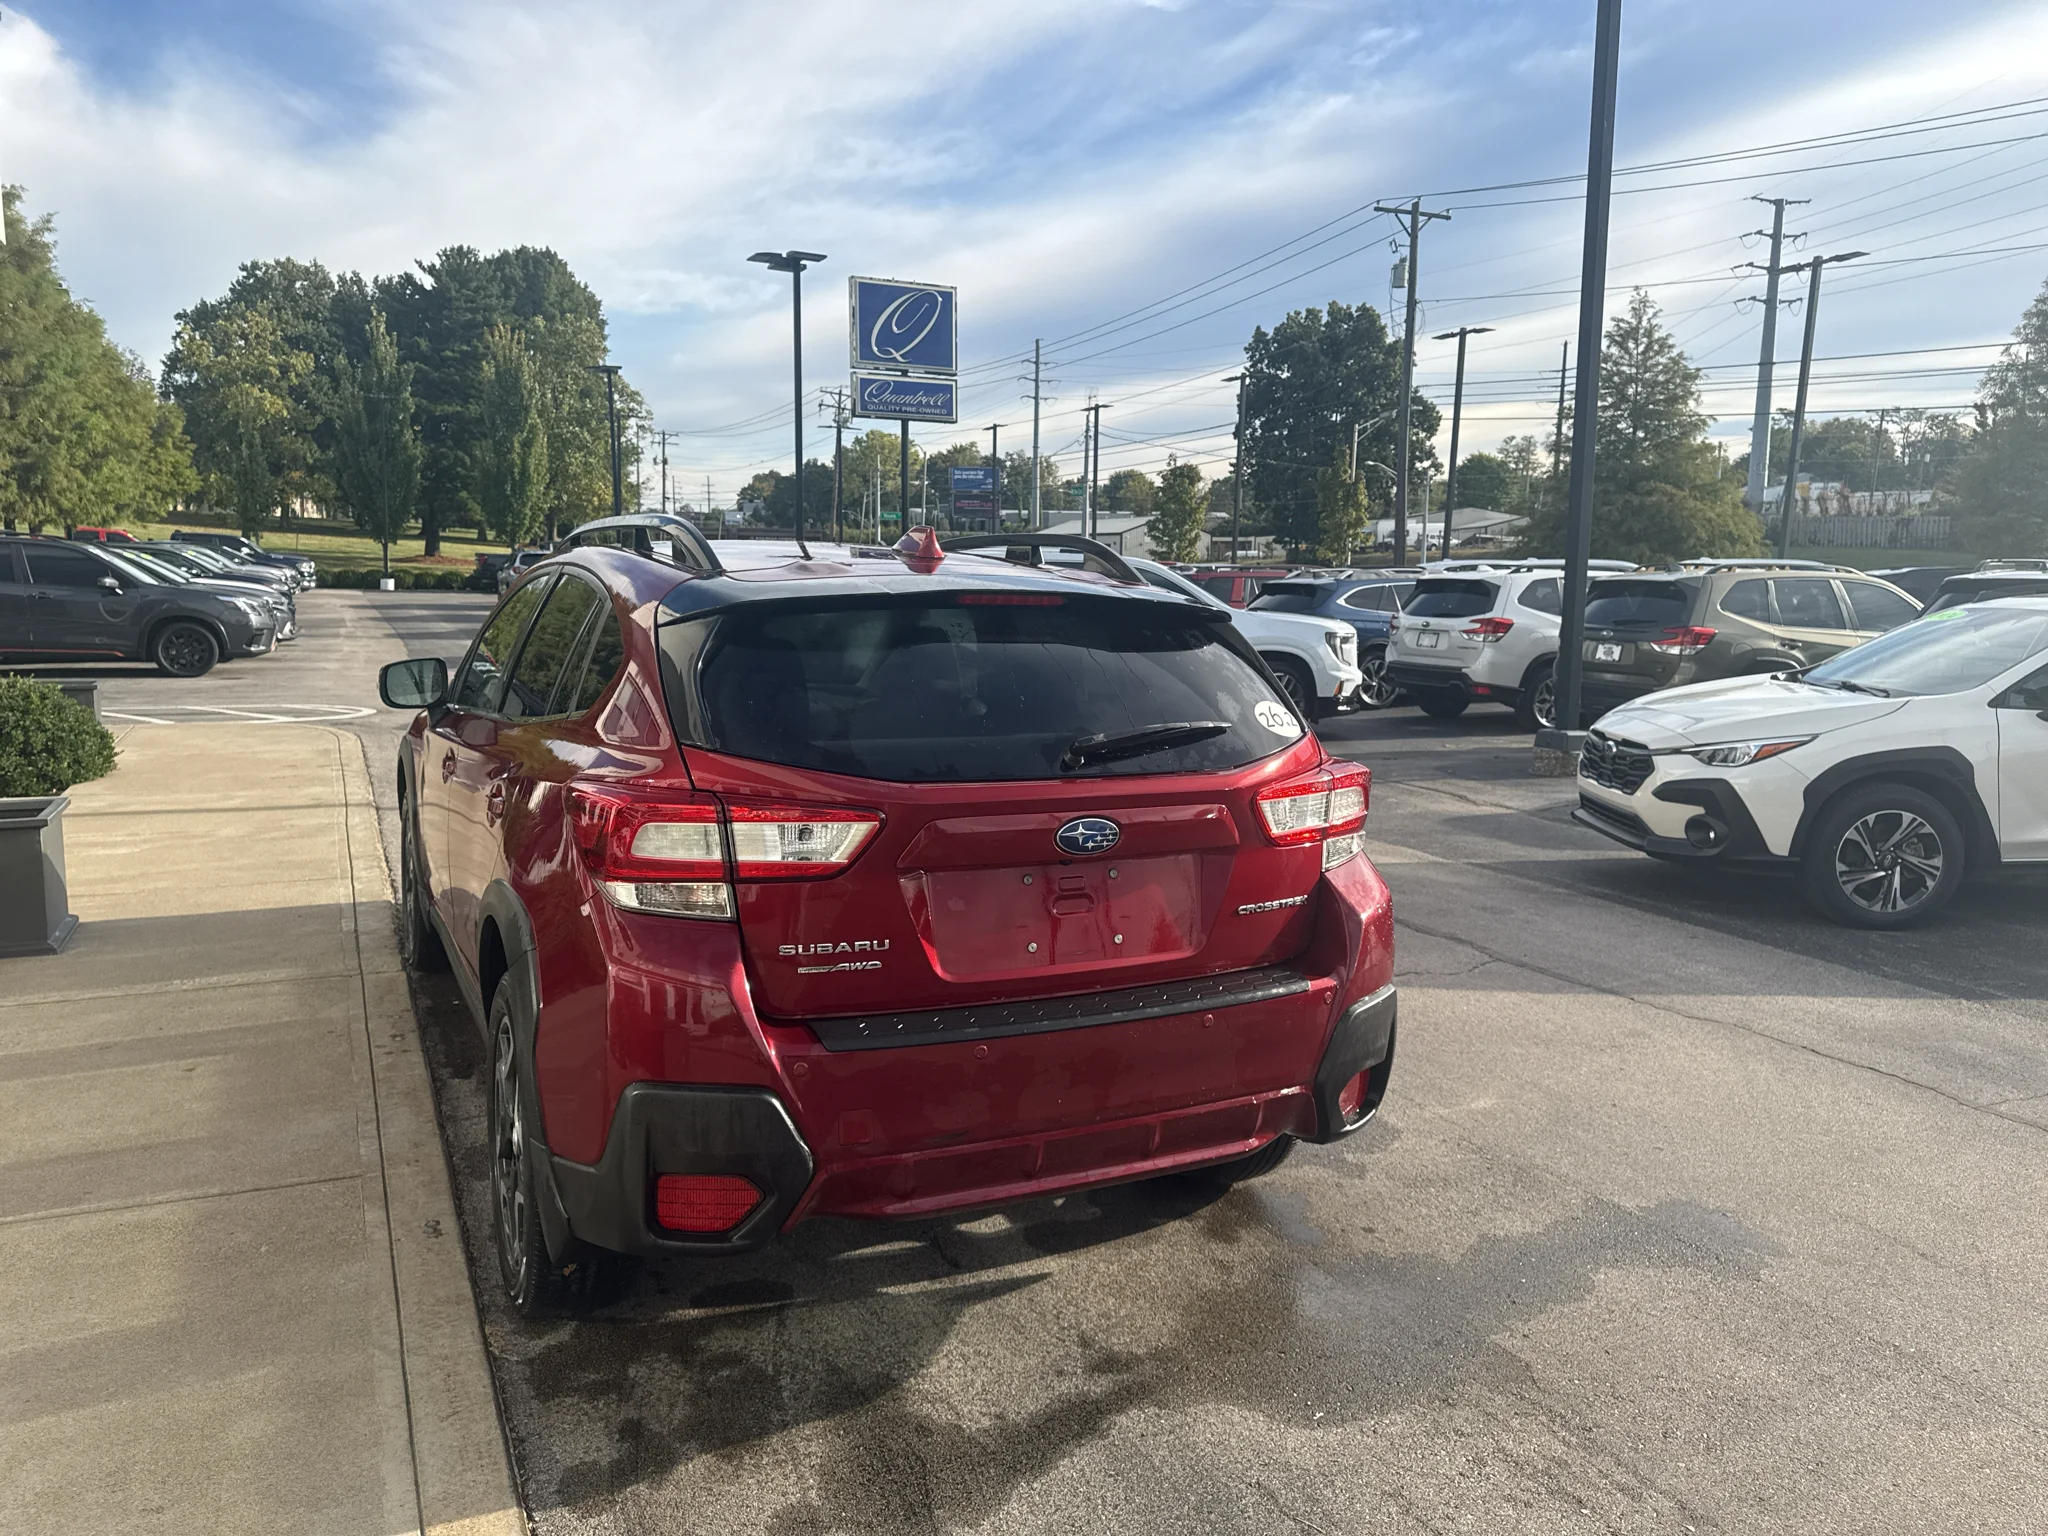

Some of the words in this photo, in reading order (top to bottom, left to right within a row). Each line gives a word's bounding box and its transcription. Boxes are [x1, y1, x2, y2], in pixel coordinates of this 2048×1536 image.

[871, 290, 943, 363] Q
[864, 380, 950, 406] Quantrell
[867, 404, 901, 412] QUALITY
[901, 406, 947, 415] PRE-OWNED
[1258, 706, 1298, 728] 26.2
[1238, 894, 1308, 915] CROSSTREK
[778, 939, 890, 956] SUBARU
[830, 960, 883, 972] AWD
